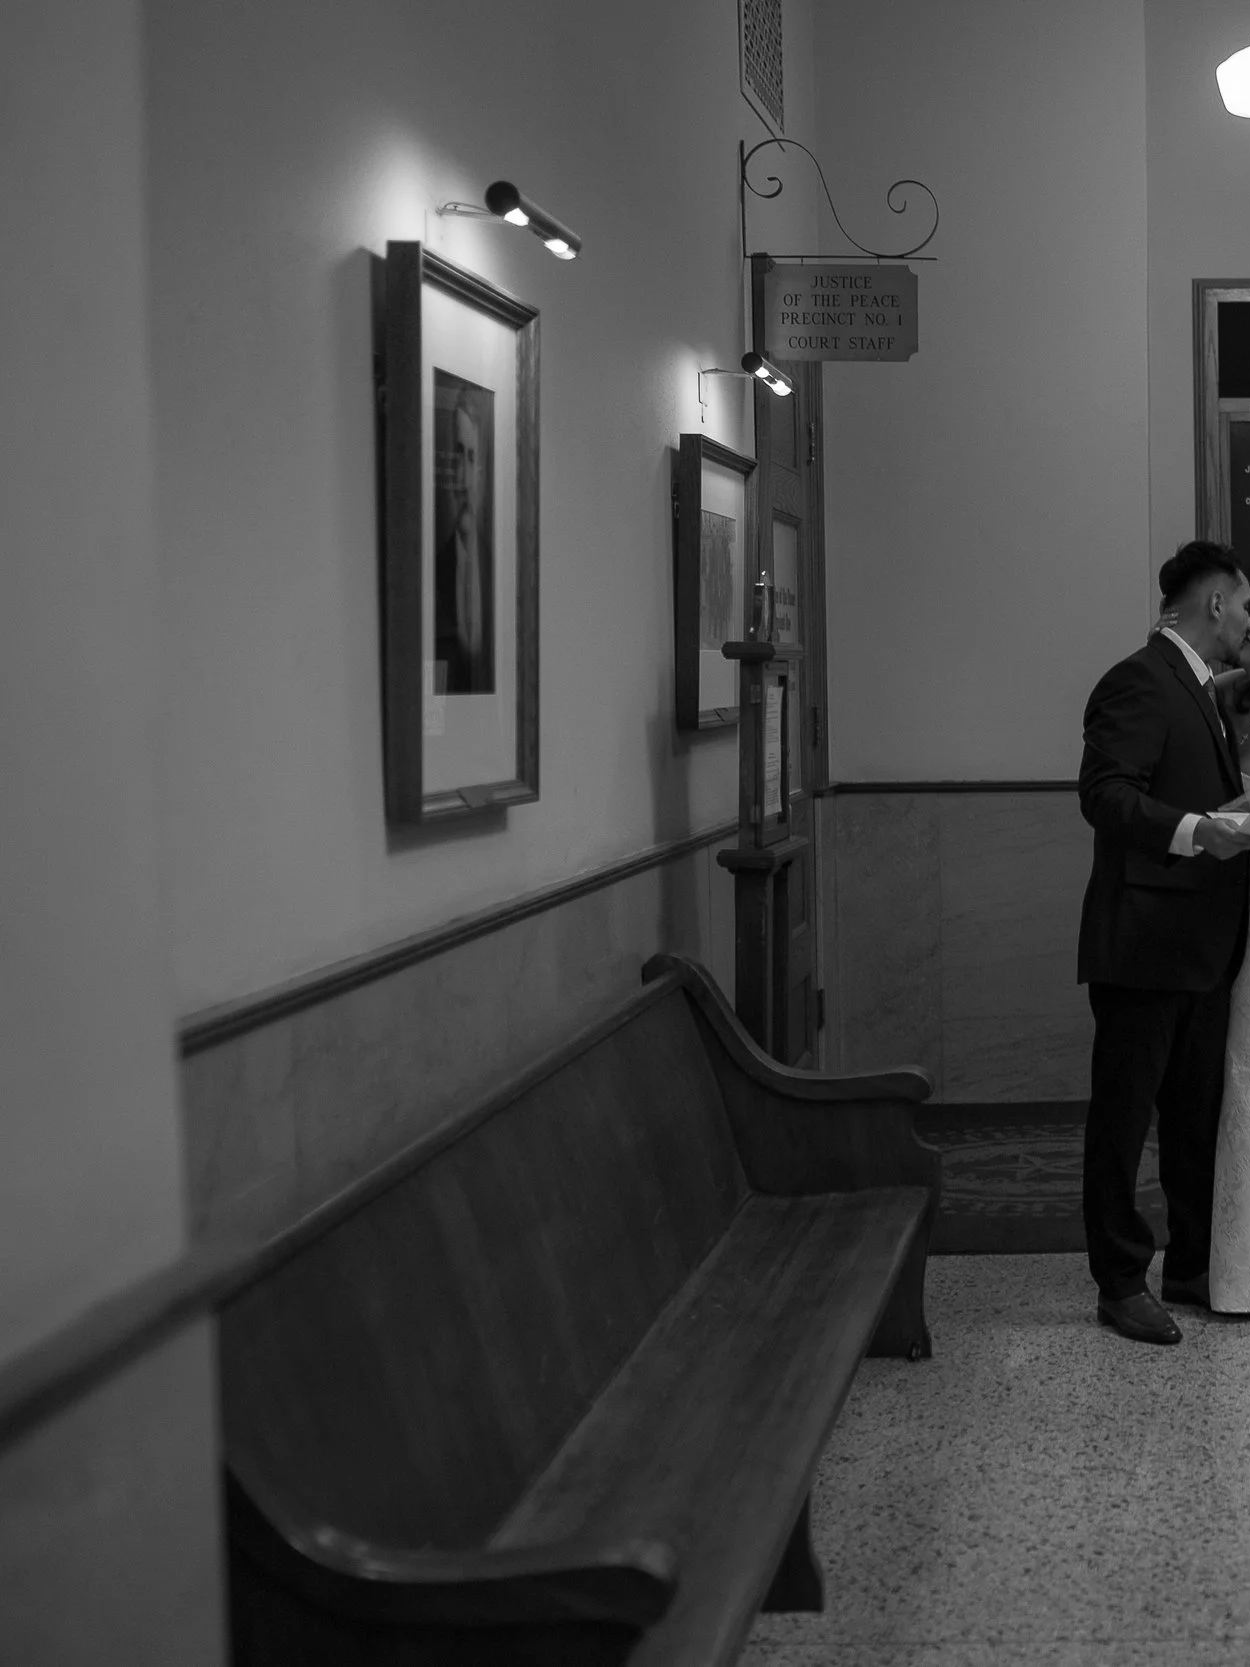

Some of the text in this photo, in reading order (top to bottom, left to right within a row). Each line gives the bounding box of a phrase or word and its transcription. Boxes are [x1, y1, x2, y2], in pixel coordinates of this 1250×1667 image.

[811, 276, 872, 289] JUSTICE
[783, 294, 900, 307] OF THE PEACE
[781, 312, 856, 325] PRECINCT
[788, 336, 895, 350] COURT STAFF
